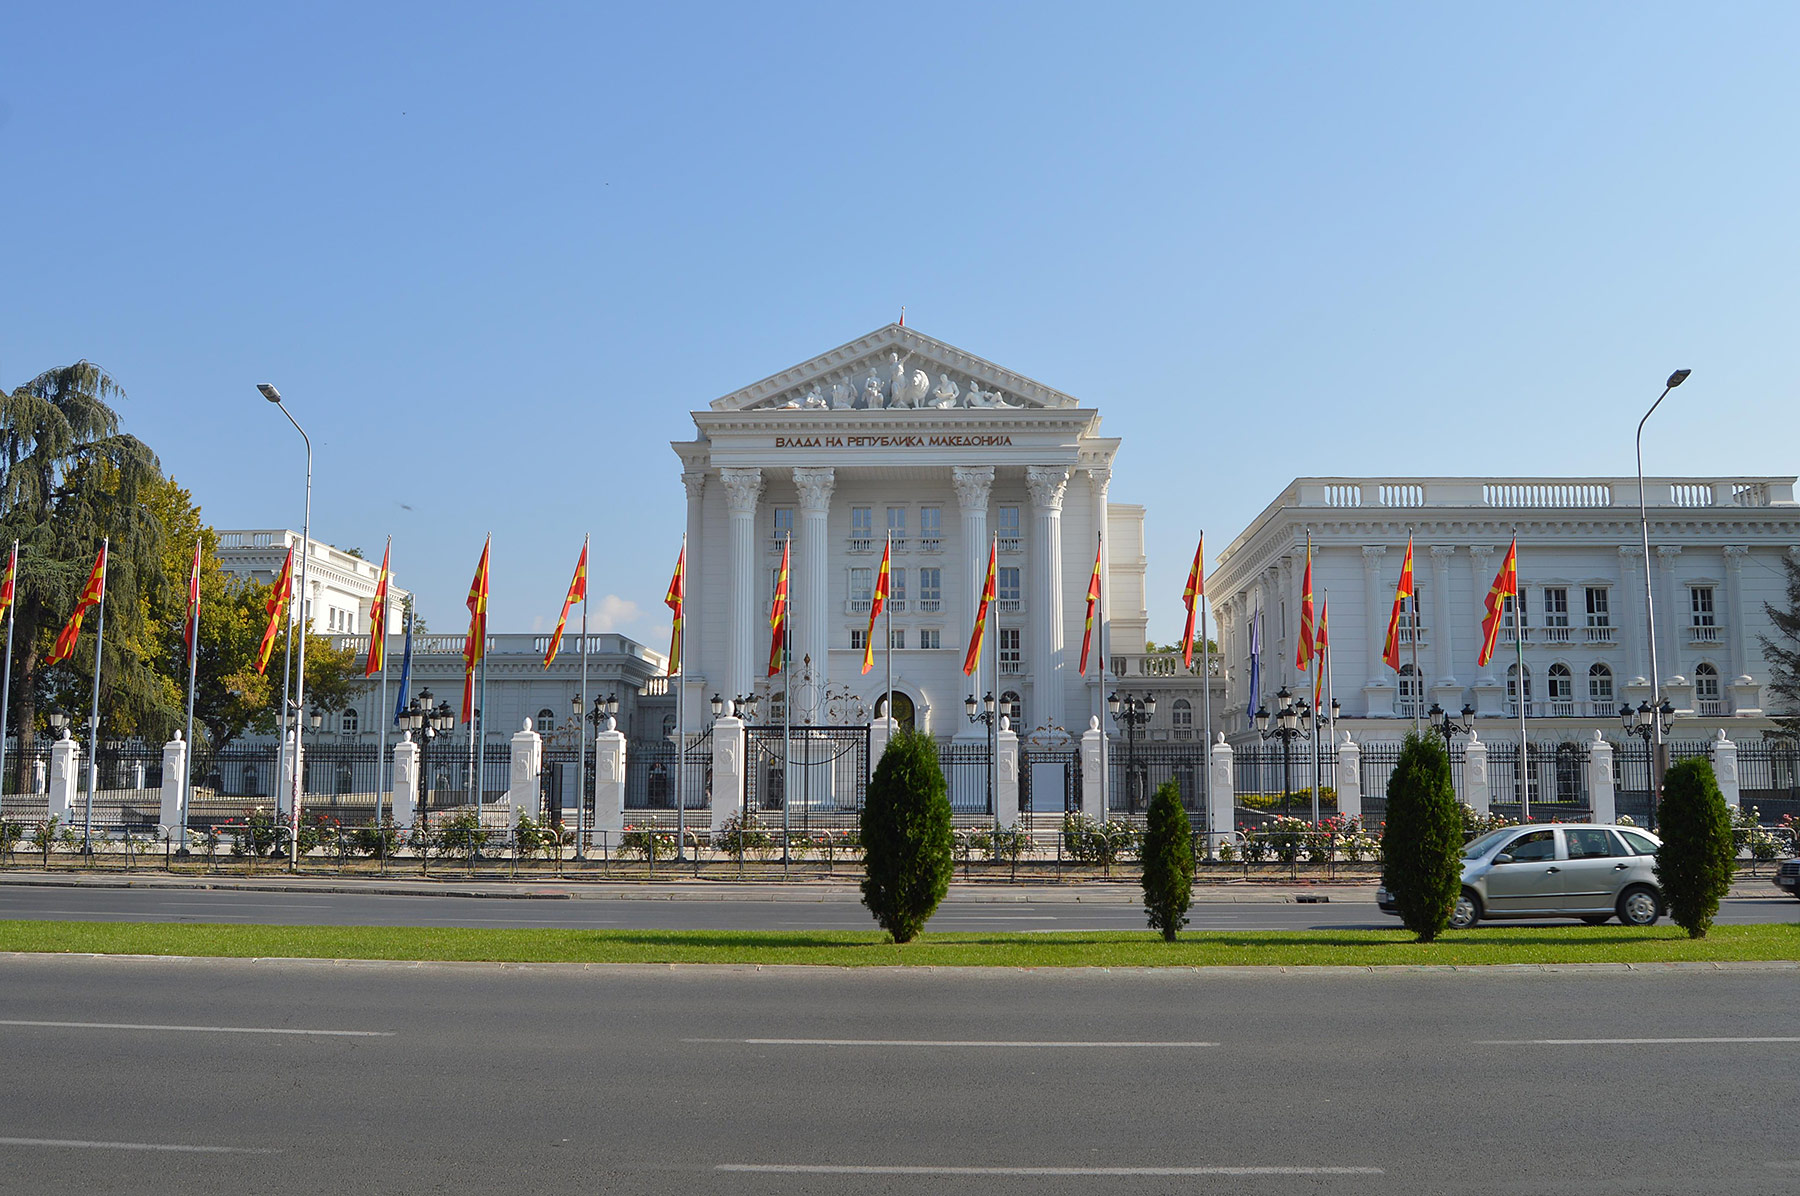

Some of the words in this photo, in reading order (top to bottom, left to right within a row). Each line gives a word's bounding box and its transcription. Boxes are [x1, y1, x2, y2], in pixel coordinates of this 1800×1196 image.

[776, 437, 821, 448] ВЛАДА
[826, 436, 843, 447] НА
[848, 436, 924, 447] РЕПУБЛИКА
[928, 435, 1012, 446] МАКЕДОНИЈА
